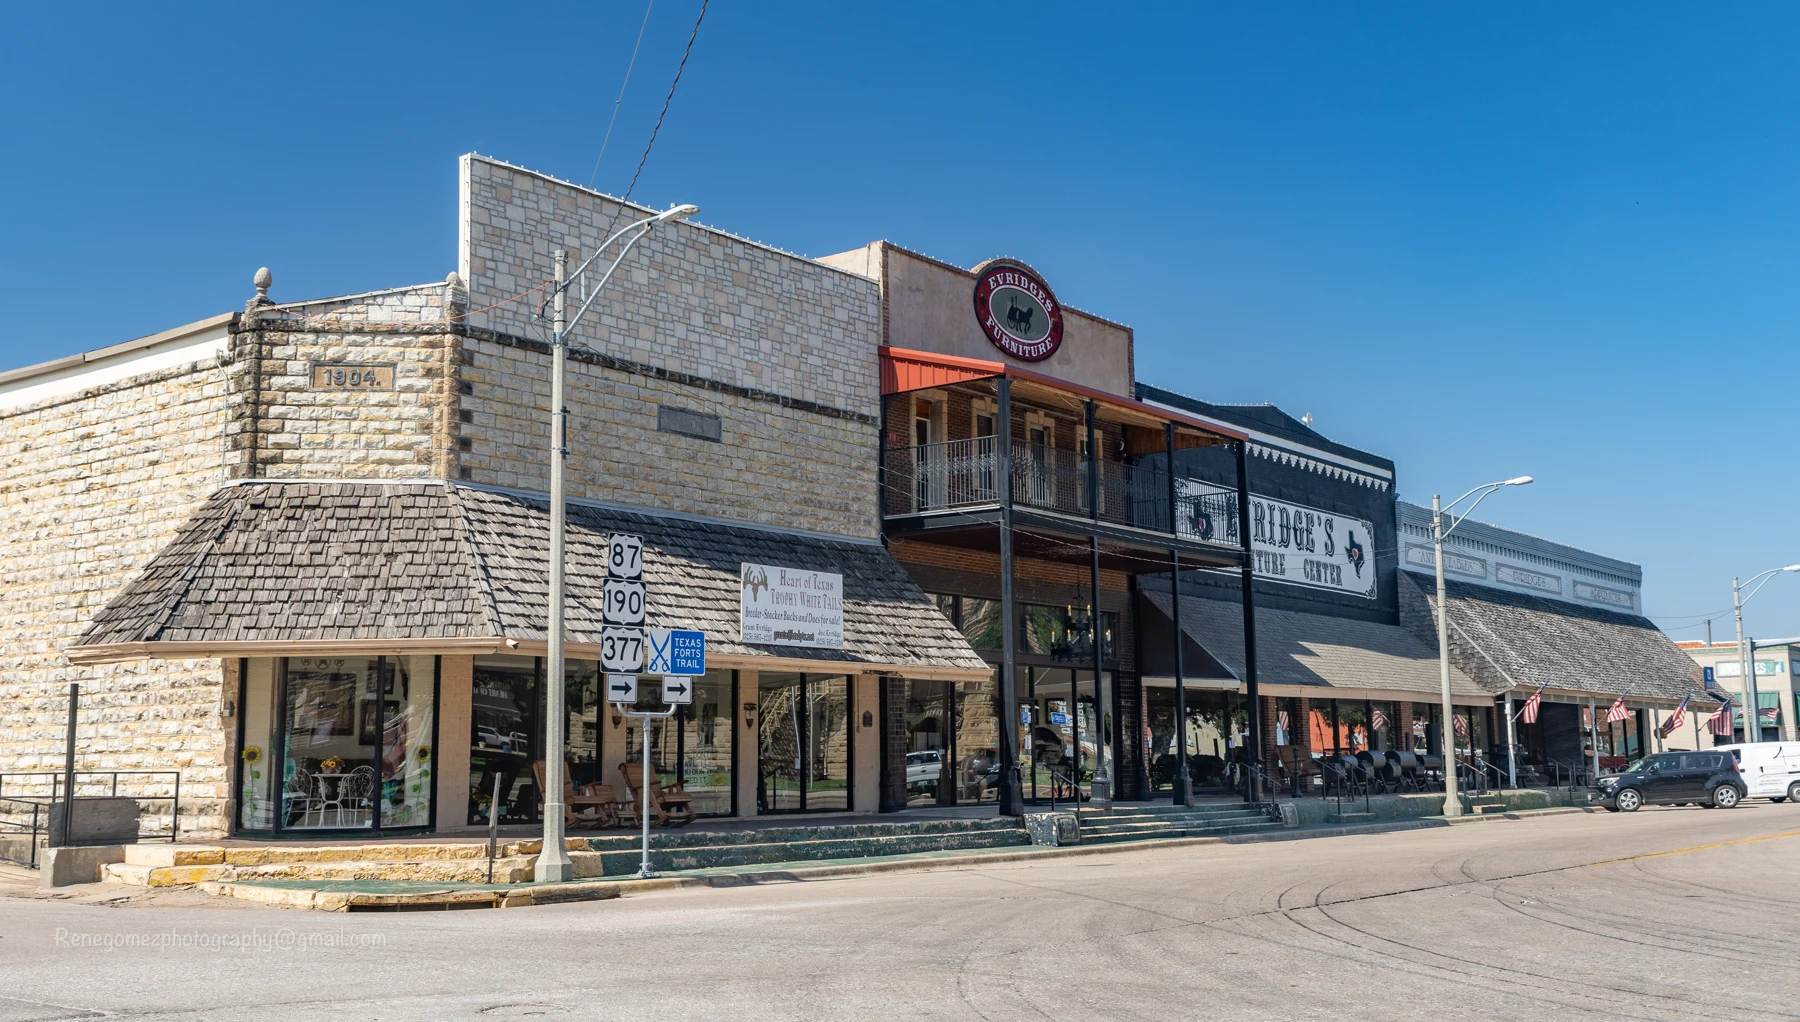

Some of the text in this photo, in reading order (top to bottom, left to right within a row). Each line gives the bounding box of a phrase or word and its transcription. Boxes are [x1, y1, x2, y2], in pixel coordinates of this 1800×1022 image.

[988, 272, 1053, 312] EVRIDGES
[986, 315, 1053, 357] FURNITURE
[612, 542, 640, 569] 87
[779, 569, 834, 591] Heart of Texas
[1303, 558, 1343, 587] CENTER
[606, 588, 641, 615] 190
[770, 588, 842, 611] TROPHY WHITE TAILS
[603, 635, 641, 662] 377
[674, 637, 702, 648] TEXAS
[674, 648, 701, 658] FORTS
[675, 658, 700, 669] TRAIL
